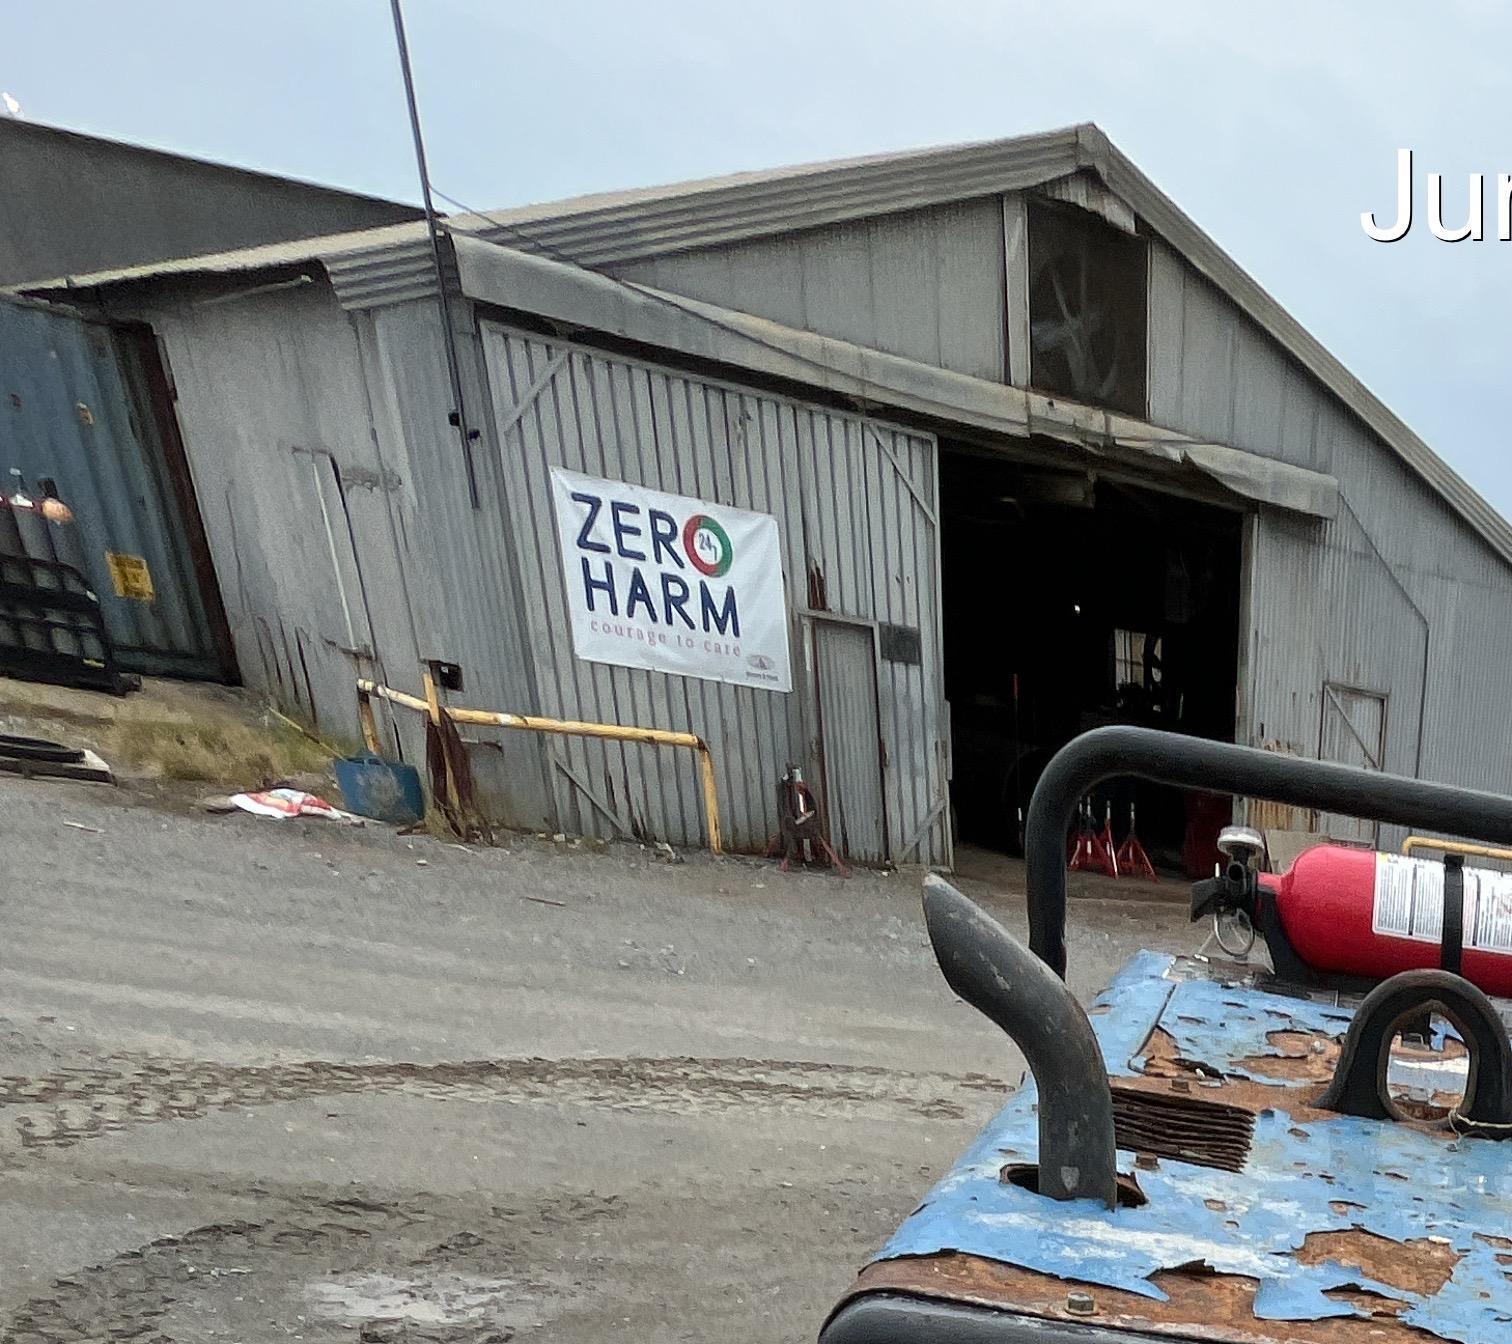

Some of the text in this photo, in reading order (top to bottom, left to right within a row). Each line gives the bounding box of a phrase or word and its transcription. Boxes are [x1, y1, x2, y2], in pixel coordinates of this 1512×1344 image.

[571, 492, 733, 577] ZERO
[581, 556, 740, 638] HARM
[590, 620, 741, 656] courage to care
